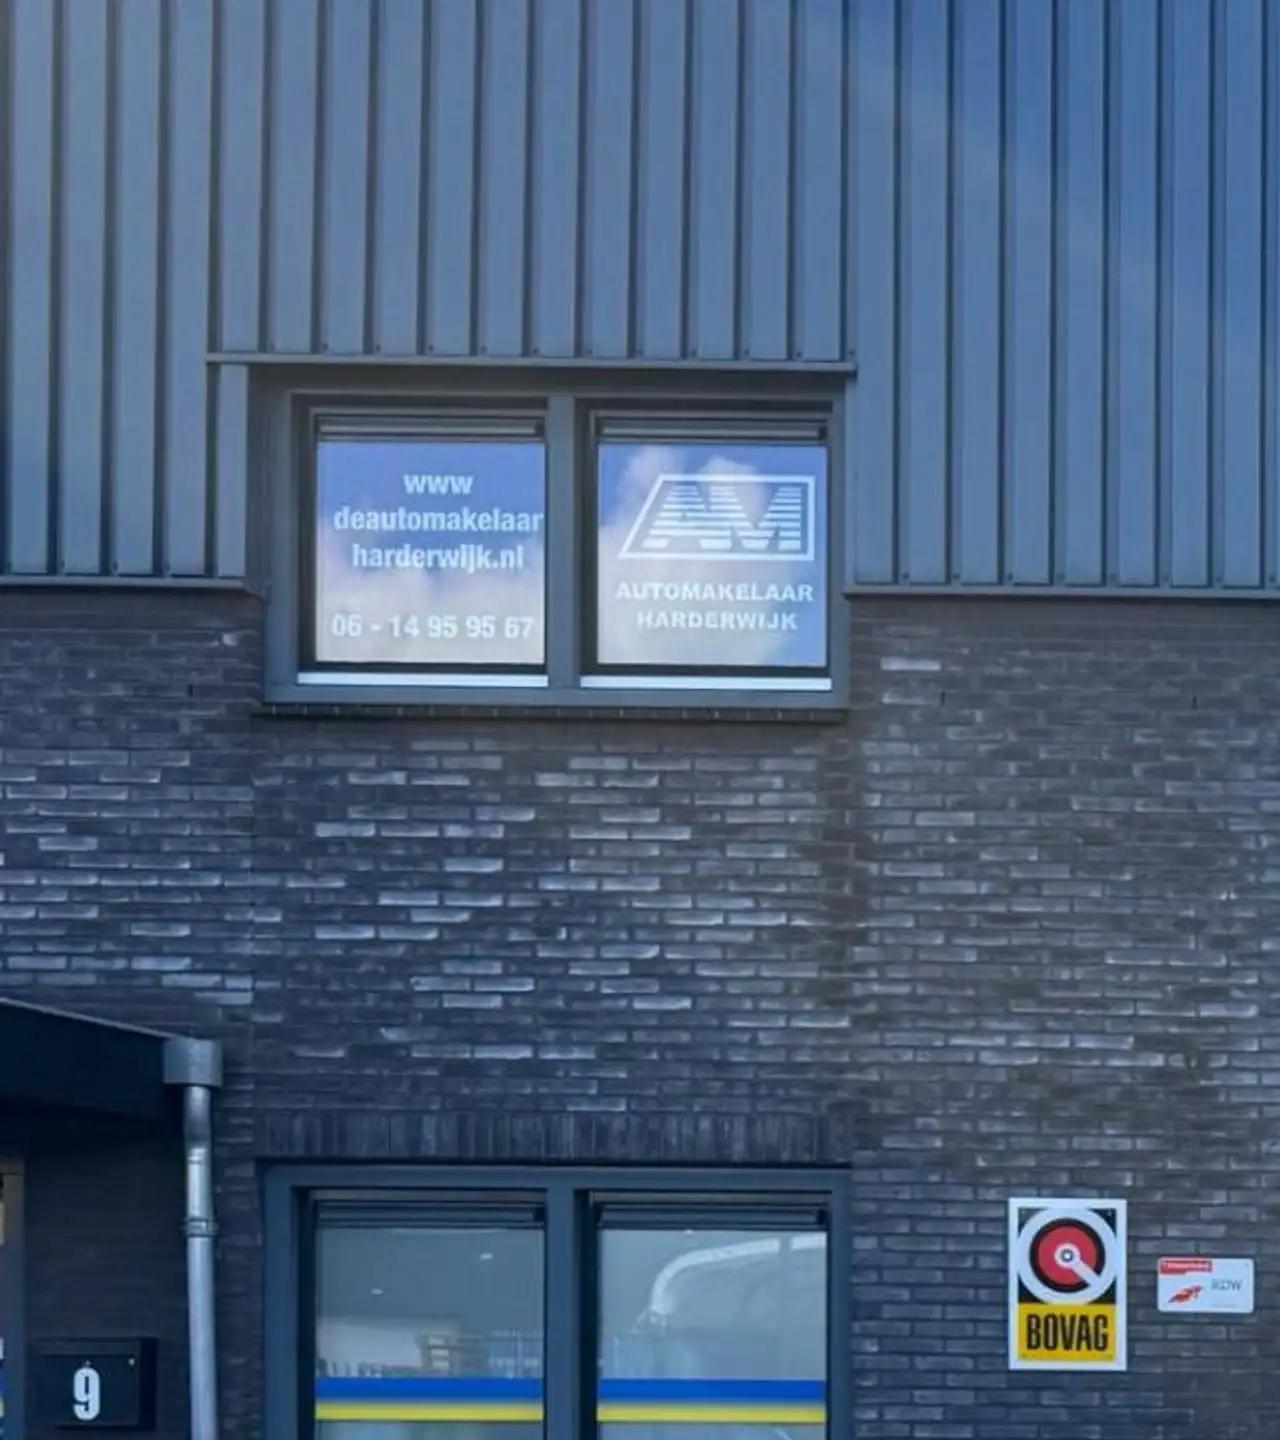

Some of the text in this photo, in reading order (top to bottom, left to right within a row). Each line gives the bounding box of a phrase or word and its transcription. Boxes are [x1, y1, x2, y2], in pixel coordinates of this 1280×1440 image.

[403, 474, 474, 495] www
[333, 506, 544, 532] deautomakelaar
[352, 544, 524, 574] harderwijk.nl
[615, 581, 814, 602] AUTOMAKELAAR
[330, 613, 363, 637] 06
[389, 615, 421, 638] 14
[428, 616, 457, 639] 95
[465, 616, 496, 639] 95
[504, 616, 534, 639] 67
[637, 611, 798, 631] HARDERWIJK
[1025, 1313, 1109, 1352] BOVAG
[73, 1367, 100, 1420] 9
